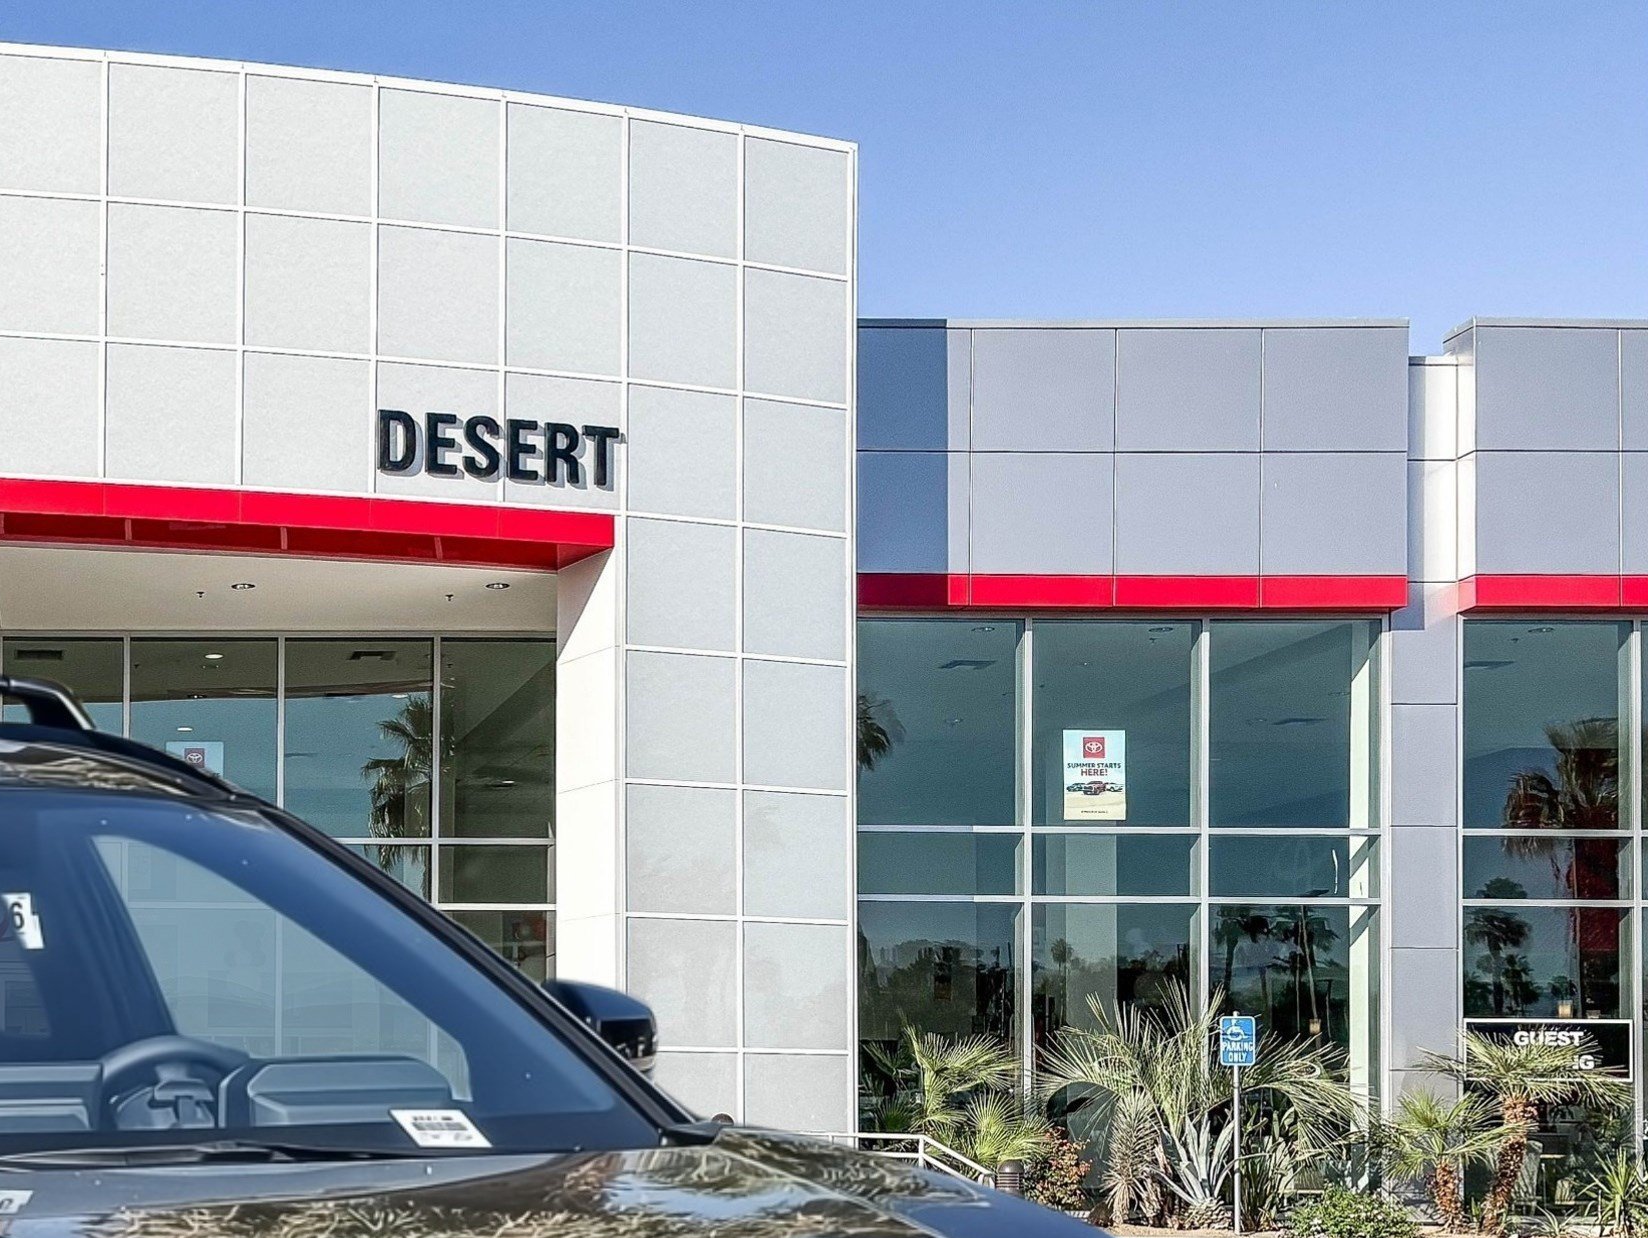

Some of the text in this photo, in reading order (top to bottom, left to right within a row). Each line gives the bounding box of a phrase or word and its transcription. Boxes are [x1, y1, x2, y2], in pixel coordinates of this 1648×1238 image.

[377, 409, 620, 486] DESERT
[1513, 1031, 1584, 1046] GUEST
[1222, 1041, 1253, 1051] PARKING
[1228, 1052, 1247, 1062] ONLY
